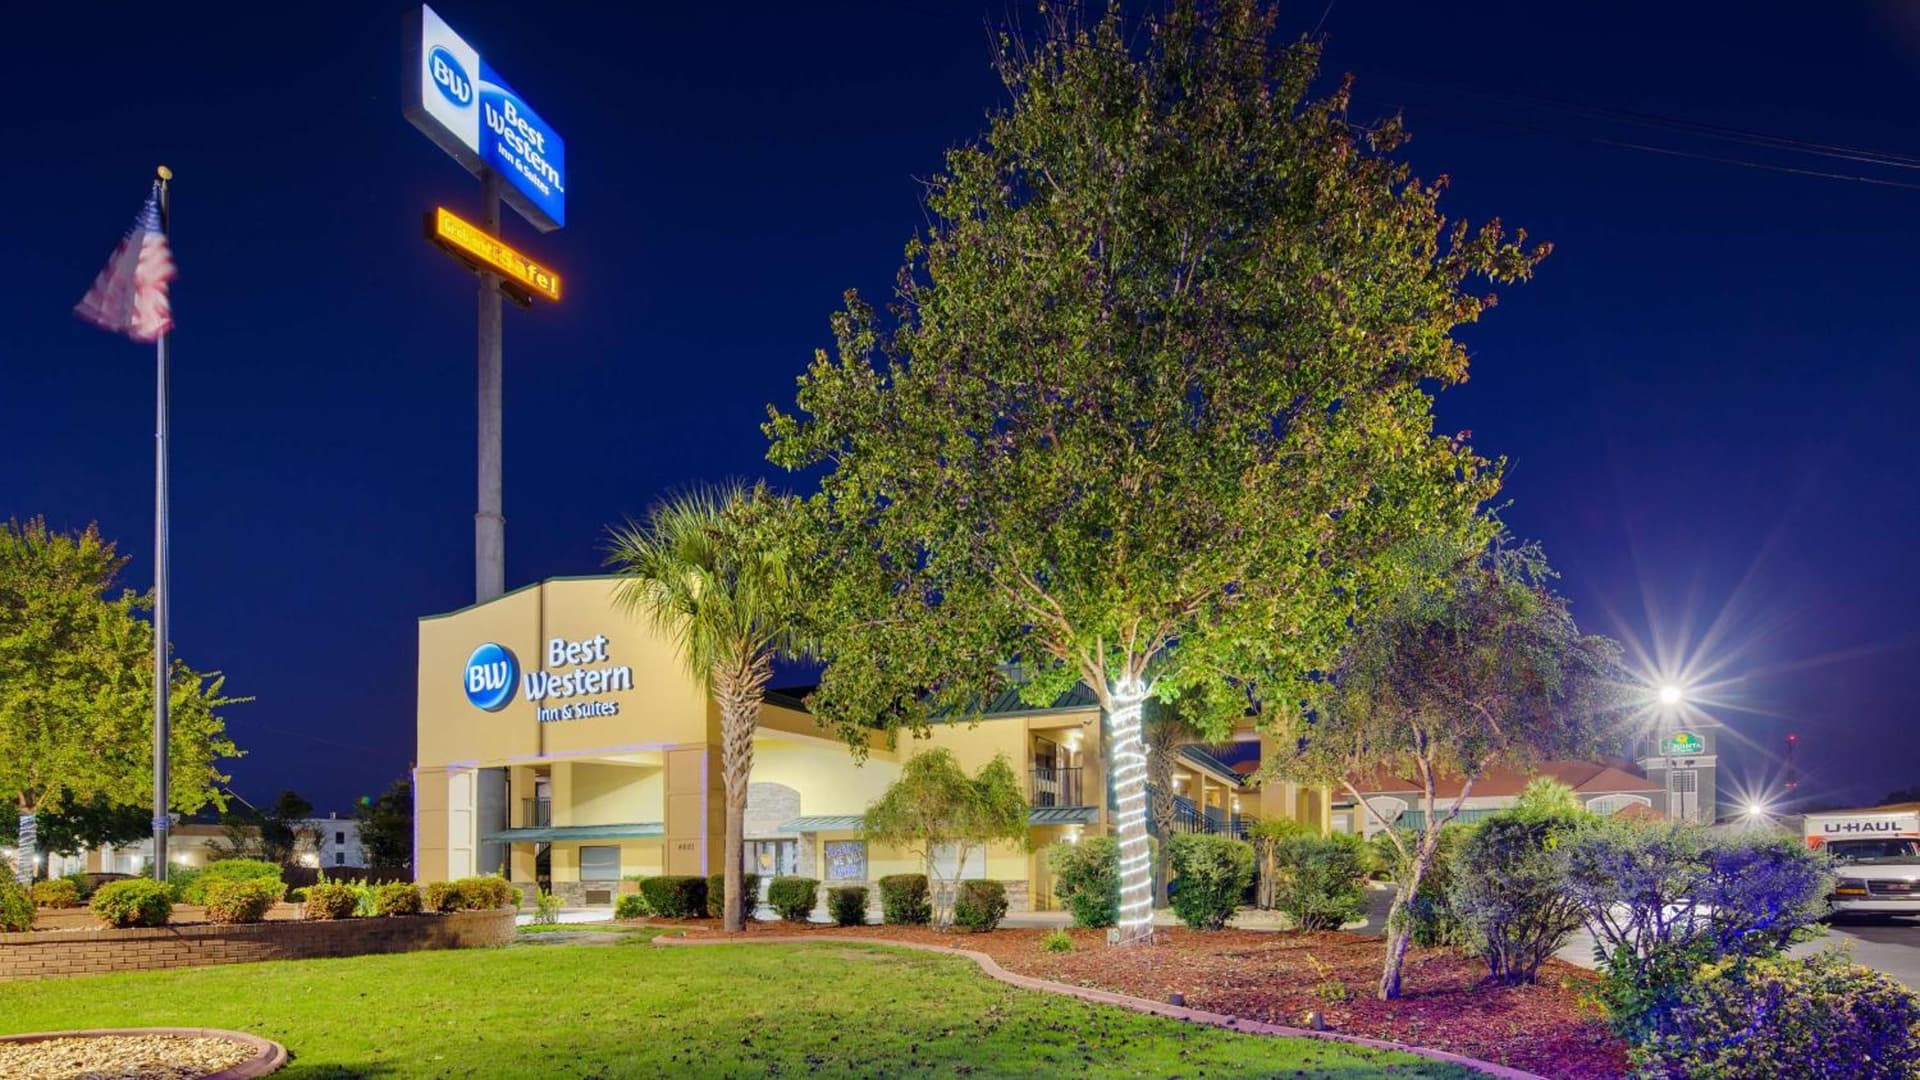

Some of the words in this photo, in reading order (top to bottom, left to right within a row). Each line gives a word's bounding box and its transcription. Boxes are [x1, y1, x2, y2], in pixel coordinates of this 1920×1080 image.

[433, 55, 470, 103] BW
[504, 98, 545, 153] Best
[498, 142, 514, 164] Inn
[515, 158, 524, 172] &
[524, 165, 550, 196] Suites
[549, 635, 609, 667] Best
[469, 661, 508, 693] BW
[524, 665, 632, 701] Western
[537, 706, 559, 723] Inn
[561, 704, 574, 720] &
[575, 700, 618, 719] Suites
[1824, 821, 1903, 833] U-HAUL
